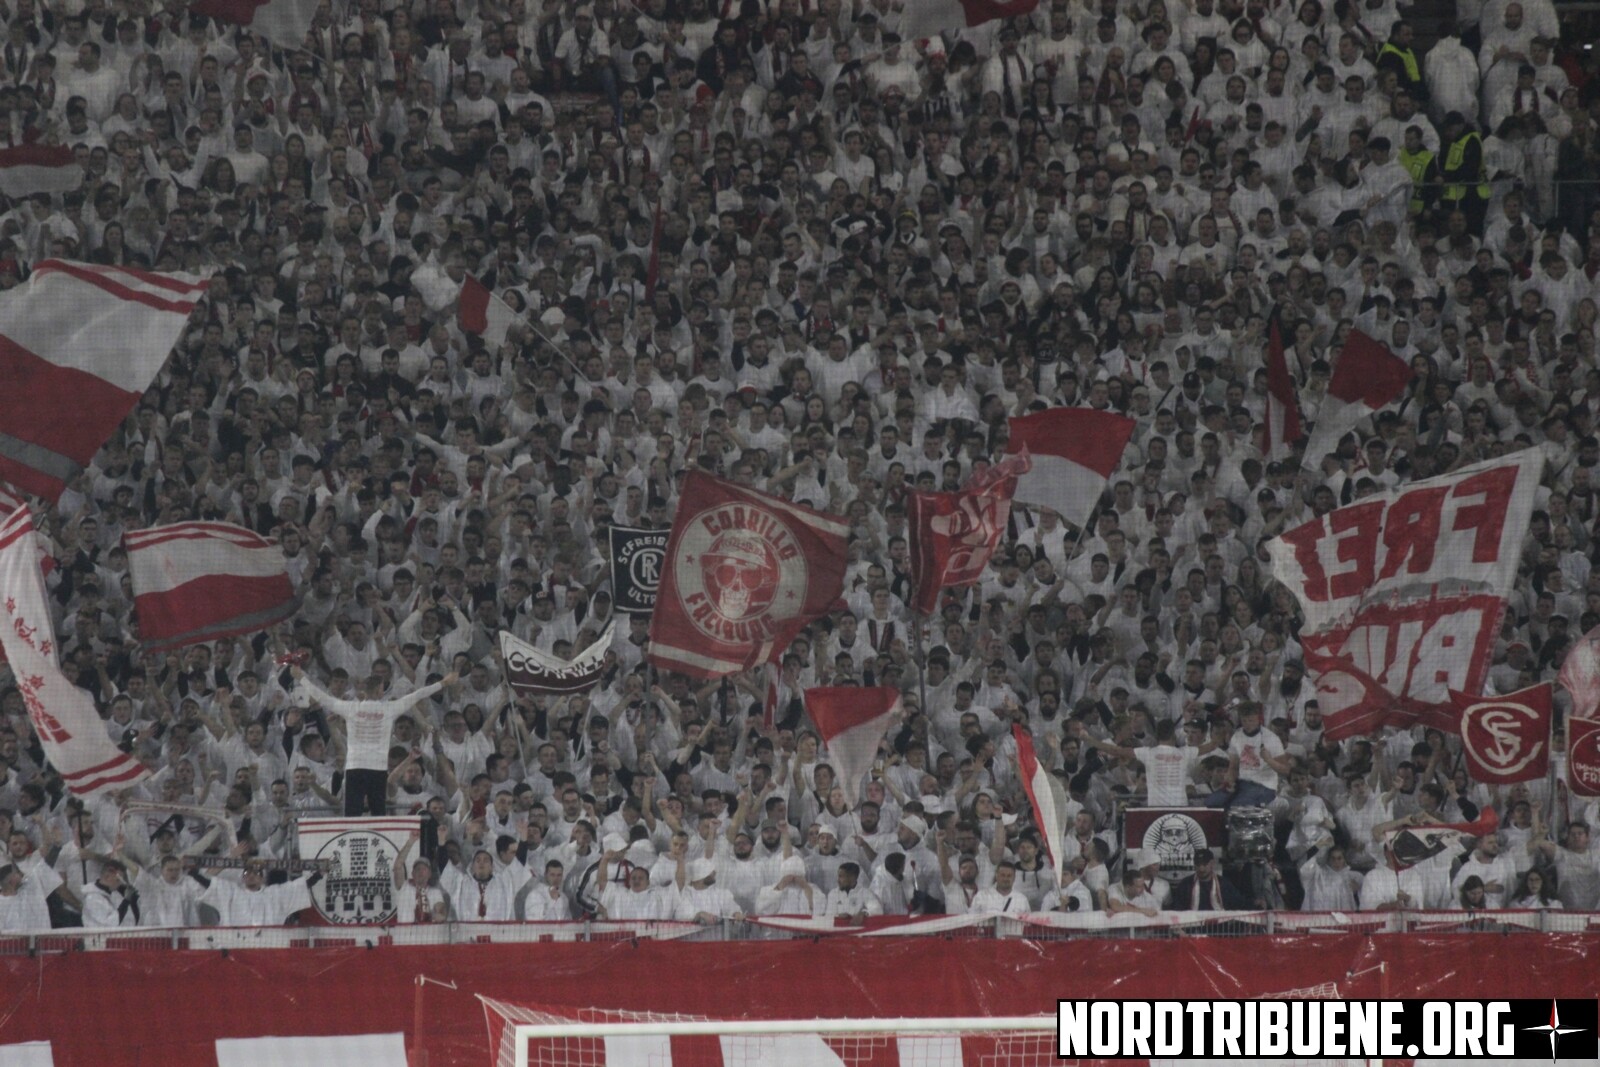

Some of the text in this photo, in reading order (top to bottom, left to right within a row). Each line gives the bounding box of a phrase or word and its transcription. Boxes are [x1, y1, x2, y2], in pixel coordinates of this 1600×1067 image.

[701, 507, 798, 561] CORRILLO
[627, 586, 657, 604] ULTR
[509, 651, 605, 679] CORRILL
